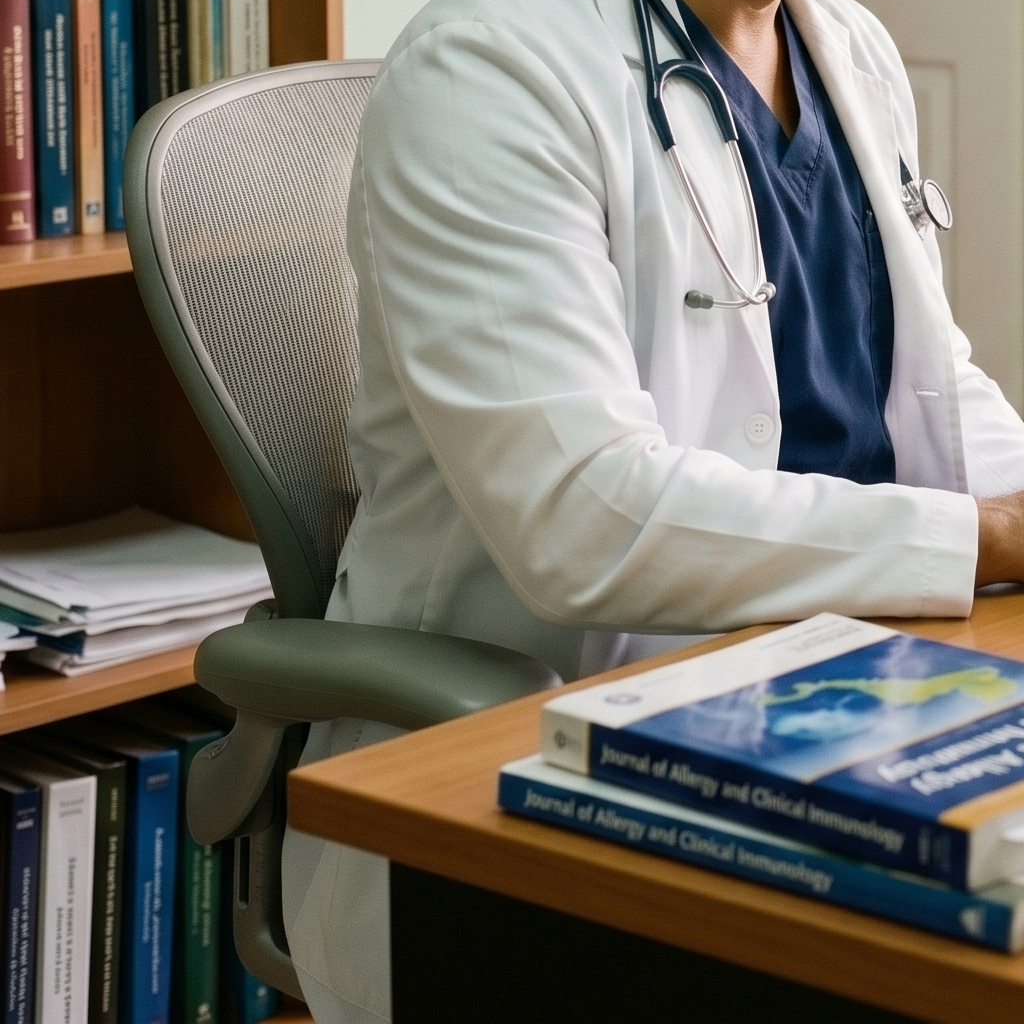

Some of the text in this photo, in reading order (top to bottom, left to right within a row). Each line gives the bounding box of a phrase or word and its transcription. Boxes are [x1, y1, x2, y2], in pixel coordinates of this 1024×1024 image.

[524, 788, 834, 894] Journal of Allergy and Clinical Immunology
[599, 743, 905, 854] Journal of Allergy and Clinical Immunology
